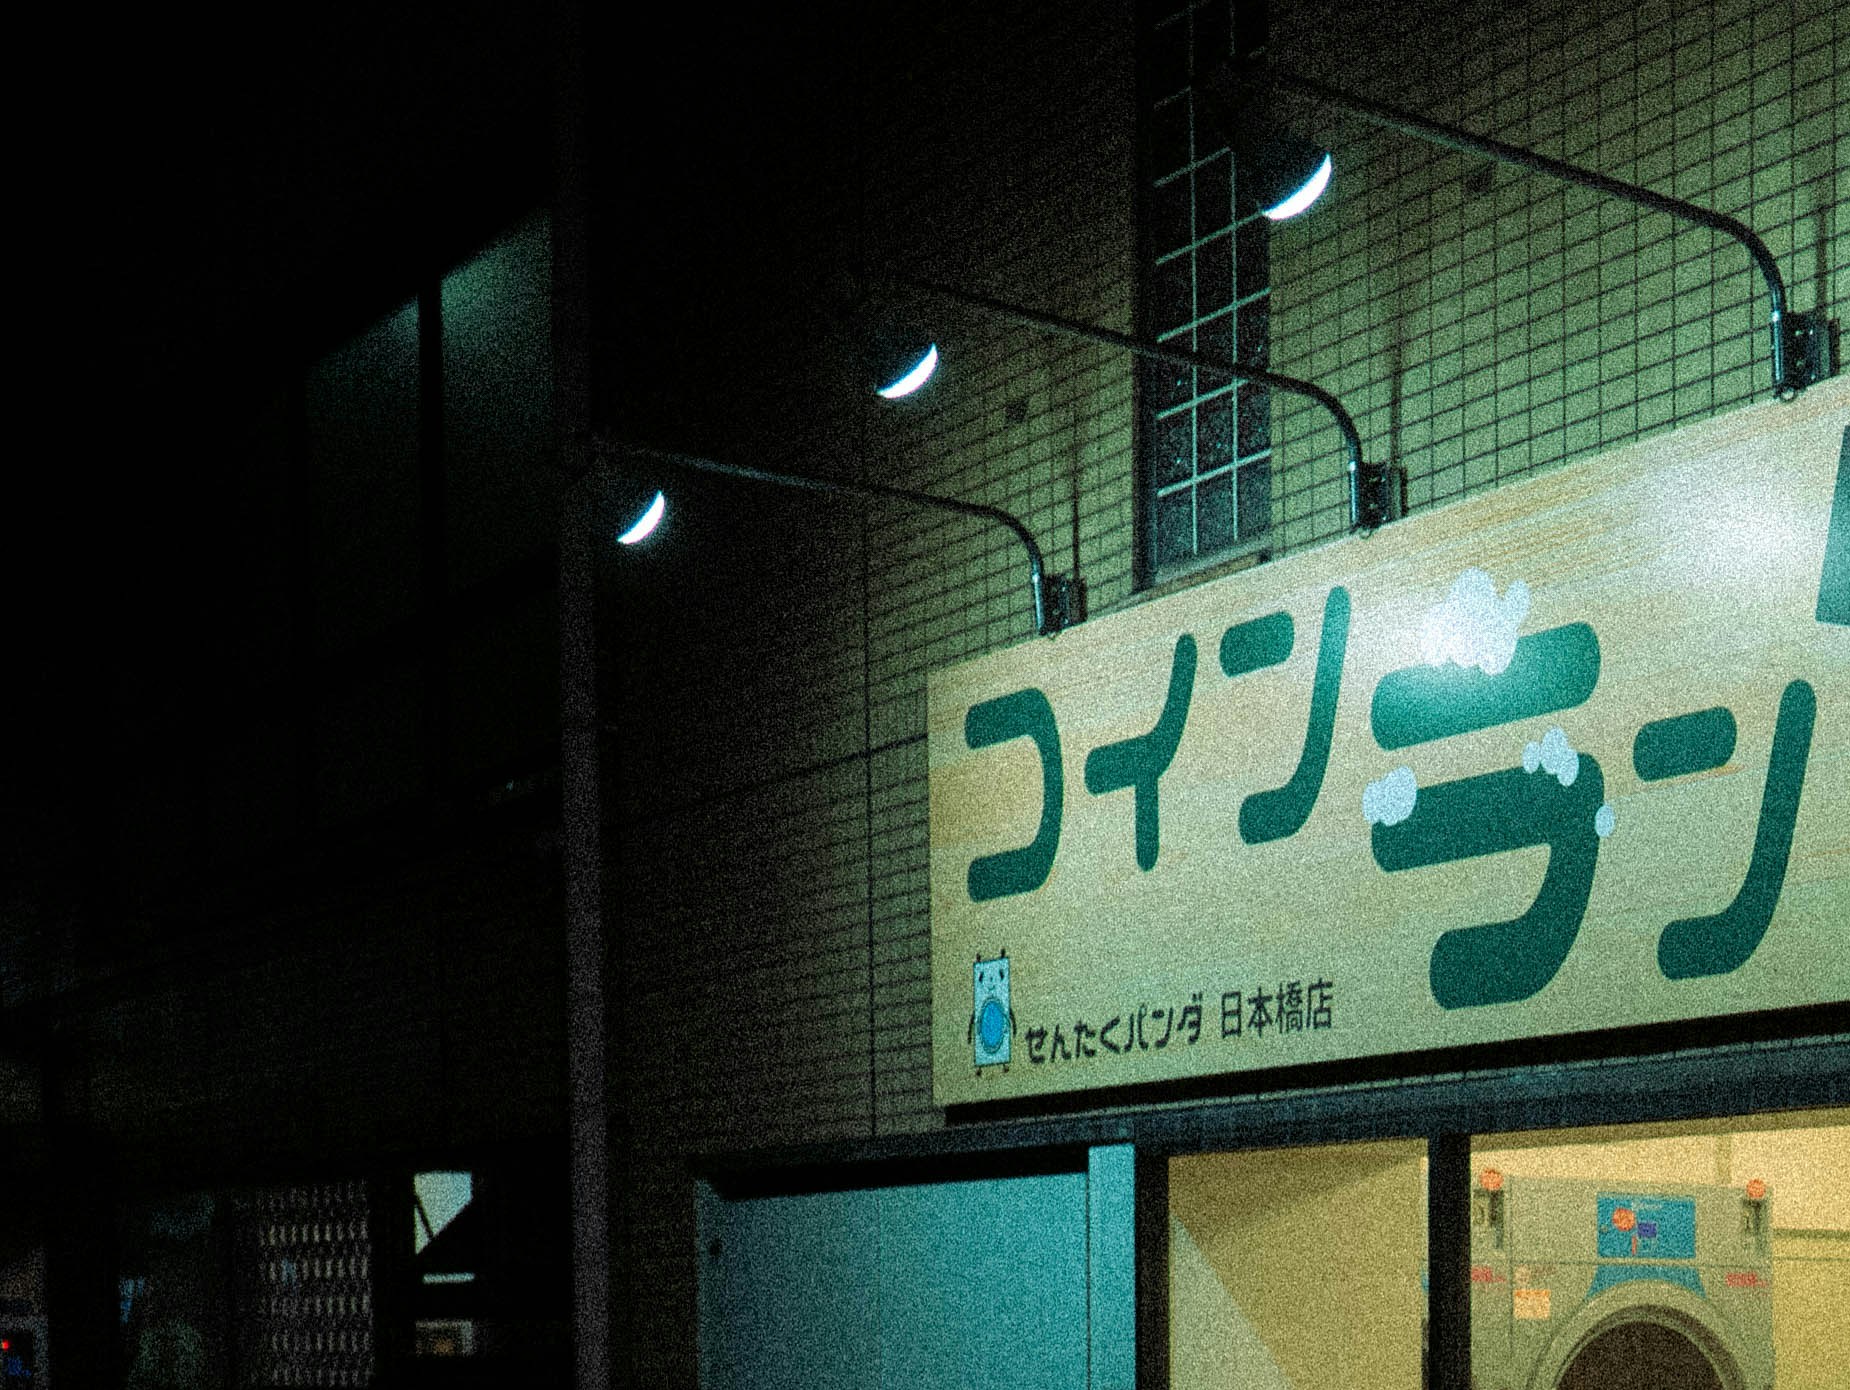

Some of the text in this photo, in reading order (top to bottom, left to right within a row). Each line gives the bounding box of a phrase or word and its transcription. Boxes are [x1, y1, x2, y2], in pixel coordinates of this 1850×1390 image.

[1025, 978, 1335, 1063] せんたくパンダ 日本橋店
